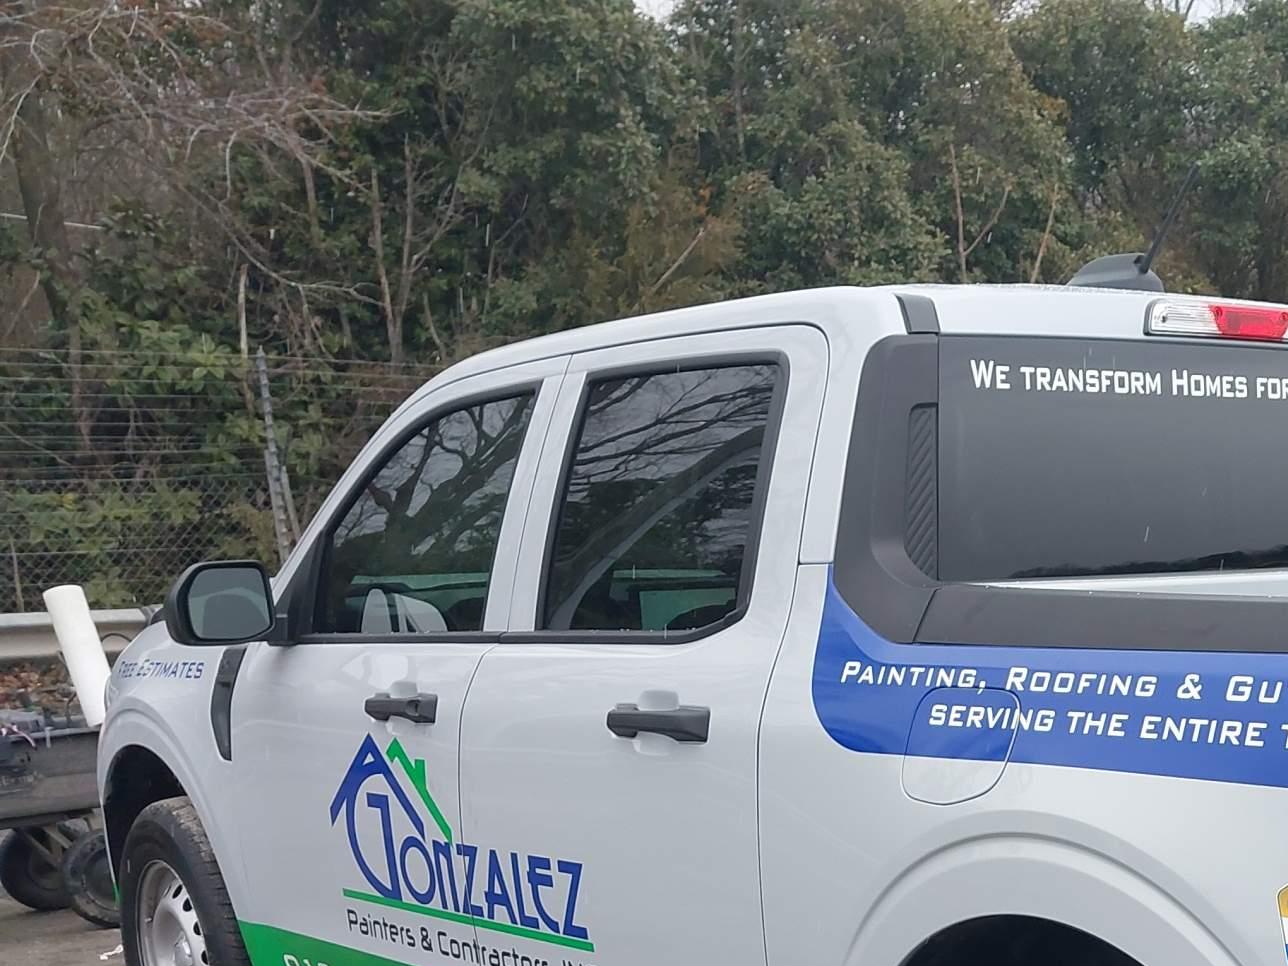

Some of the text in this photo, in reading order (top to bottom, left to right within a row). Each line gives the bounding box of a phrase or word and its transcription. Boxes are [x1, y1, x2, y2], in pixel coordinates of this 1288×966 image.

[969, 359, 1010, 390] WE
[1020, 366, 1162, 395] TRANSFORM
[1171, 370, 1248, 398] HOMES
[136, 659, 204, 679] ESTIMATES
[840, 660, 987, 695] PAINTING,
[1005, 667, 1157, 698] ROOFING
[1176, 674, 1202, 700] &
[928, 704, 1056, 732] SERVING
[1067, 711, 1126, 737] THE
[1139, 716, 1268, 747] ENTIRE
[346, 908, 416, 945] Painters
[420, 926, 434, 952] &
